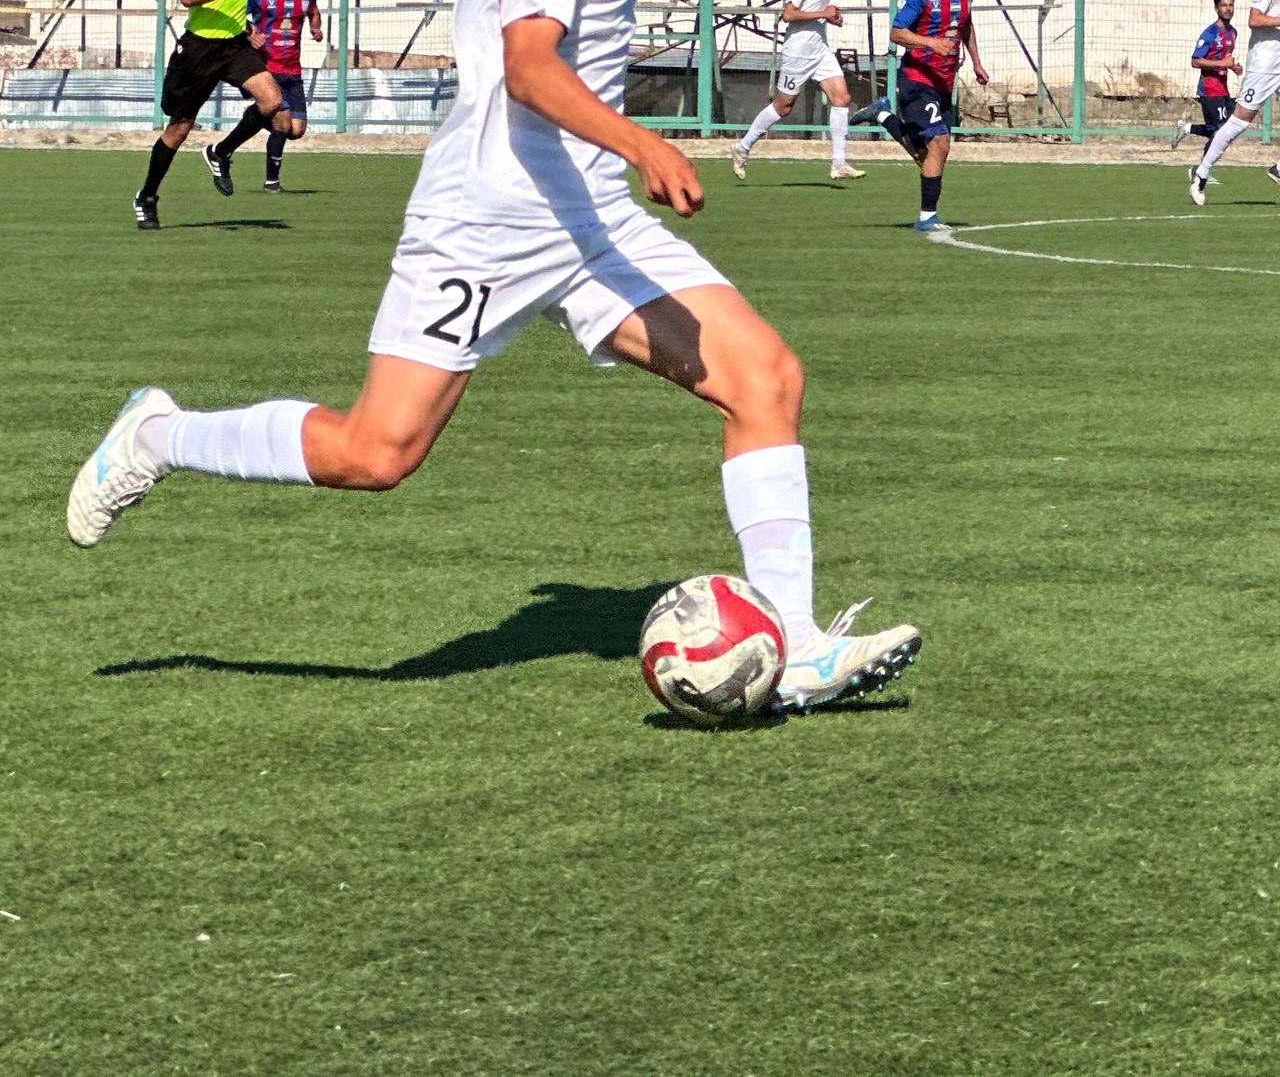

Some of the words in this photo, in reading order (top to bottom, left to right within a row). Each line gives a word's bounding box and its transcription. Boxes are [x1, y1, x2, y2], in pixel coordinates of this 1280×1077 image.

[782, 75, 796, 91] 16
[1244, 88, 1255, 103] 8
[423, 277, 492, 348] 21
